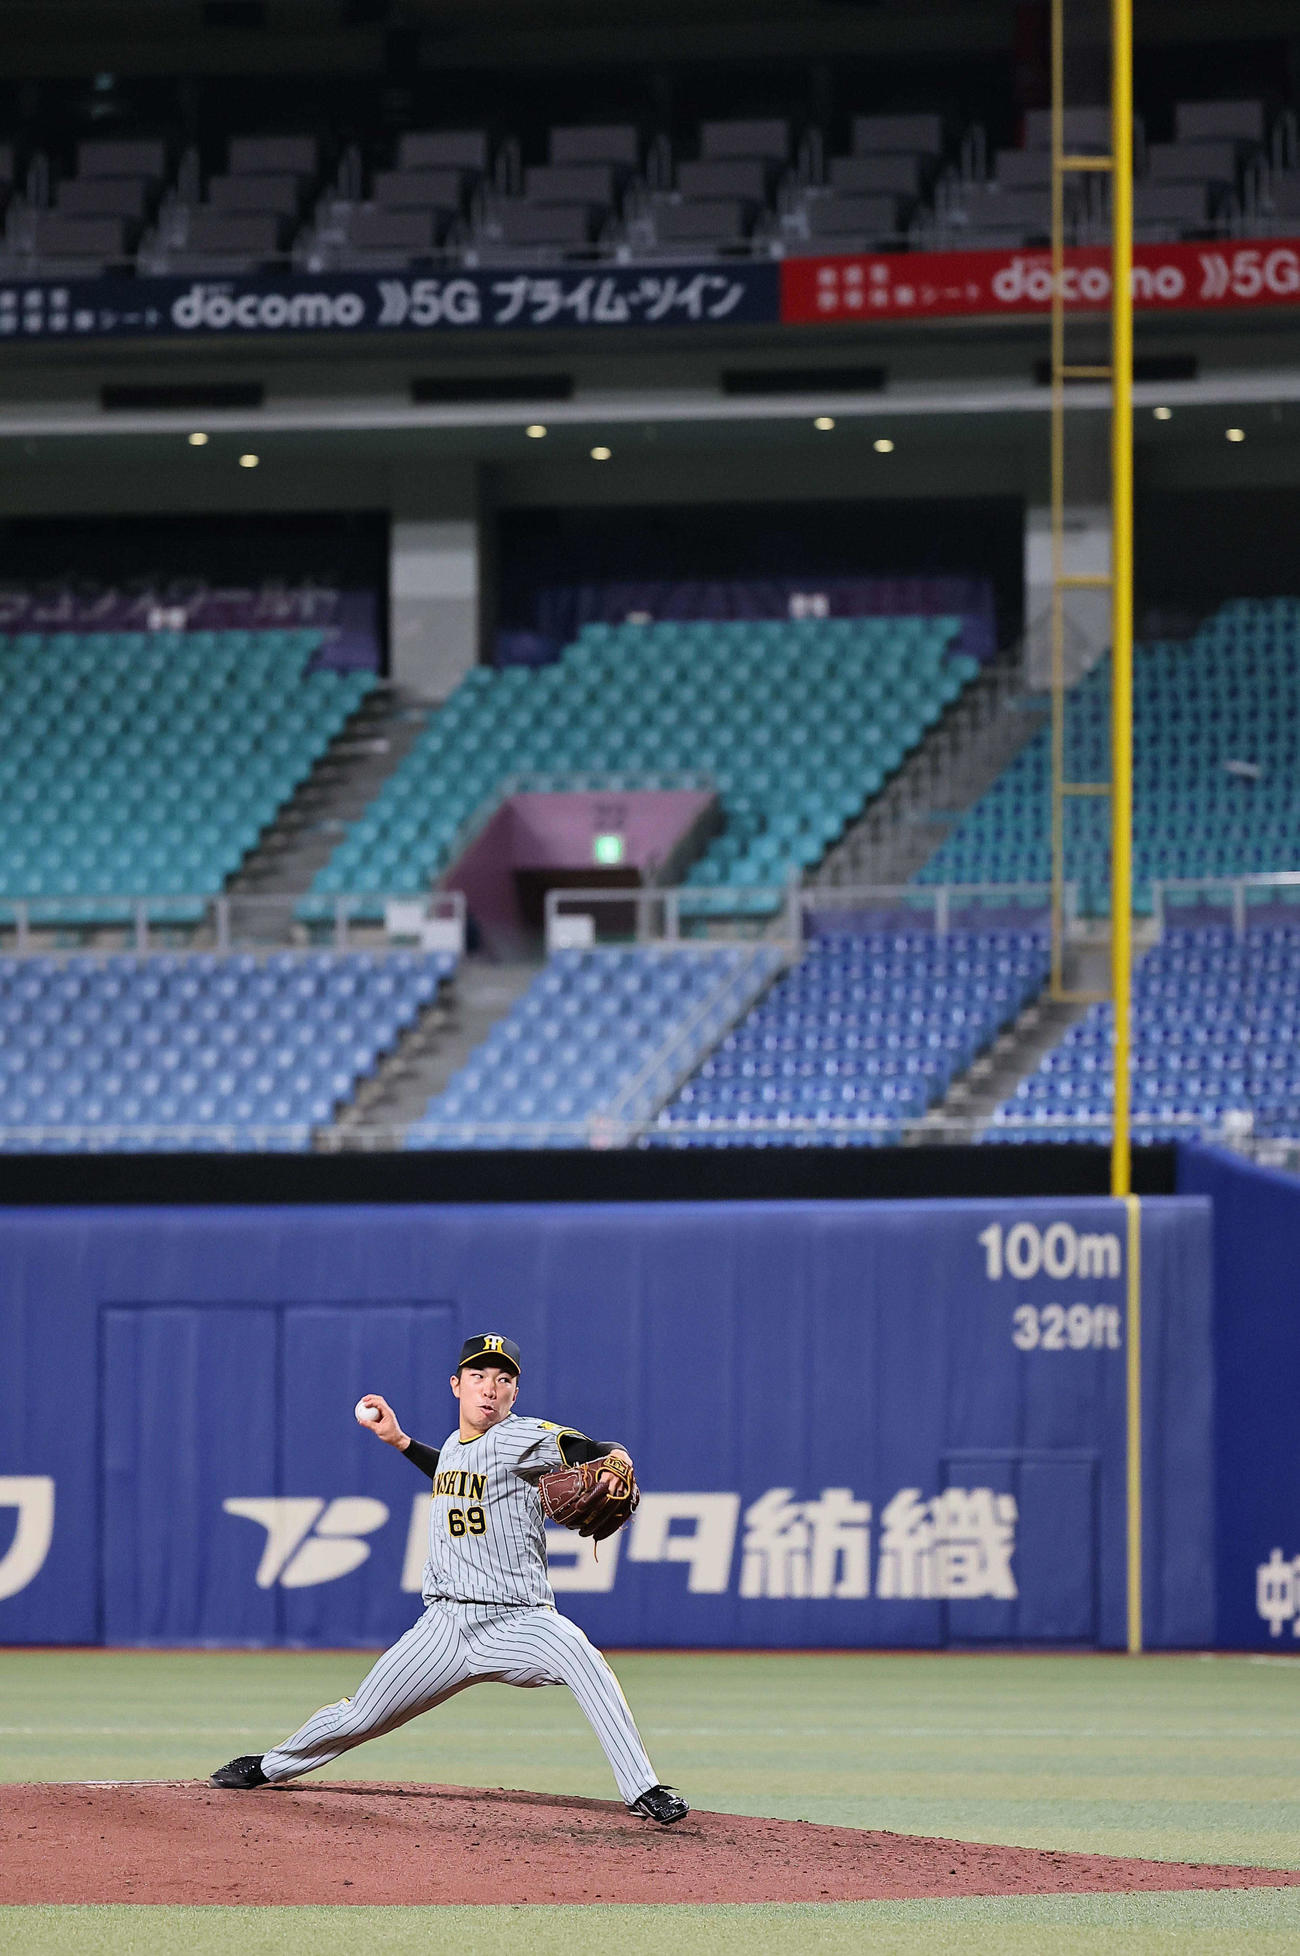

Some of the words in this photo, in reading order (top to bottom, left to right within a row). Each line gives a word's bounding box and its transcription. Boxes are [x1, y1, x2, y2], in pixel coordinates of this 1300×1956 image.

[1231, 249, 1300, 298] 5G
[172, 284, 364, 328] docomo
[410, 279, 482, 325] 5G
[978, 1221, 1122, 1280] 100m
[1012, 1303, 1122, 1351] 329ft
[432, 1470, 488, 1501] NSHIN
[448, 1506, 488, 1538] 69
[1257, 1548, 1300, 1638] 中
